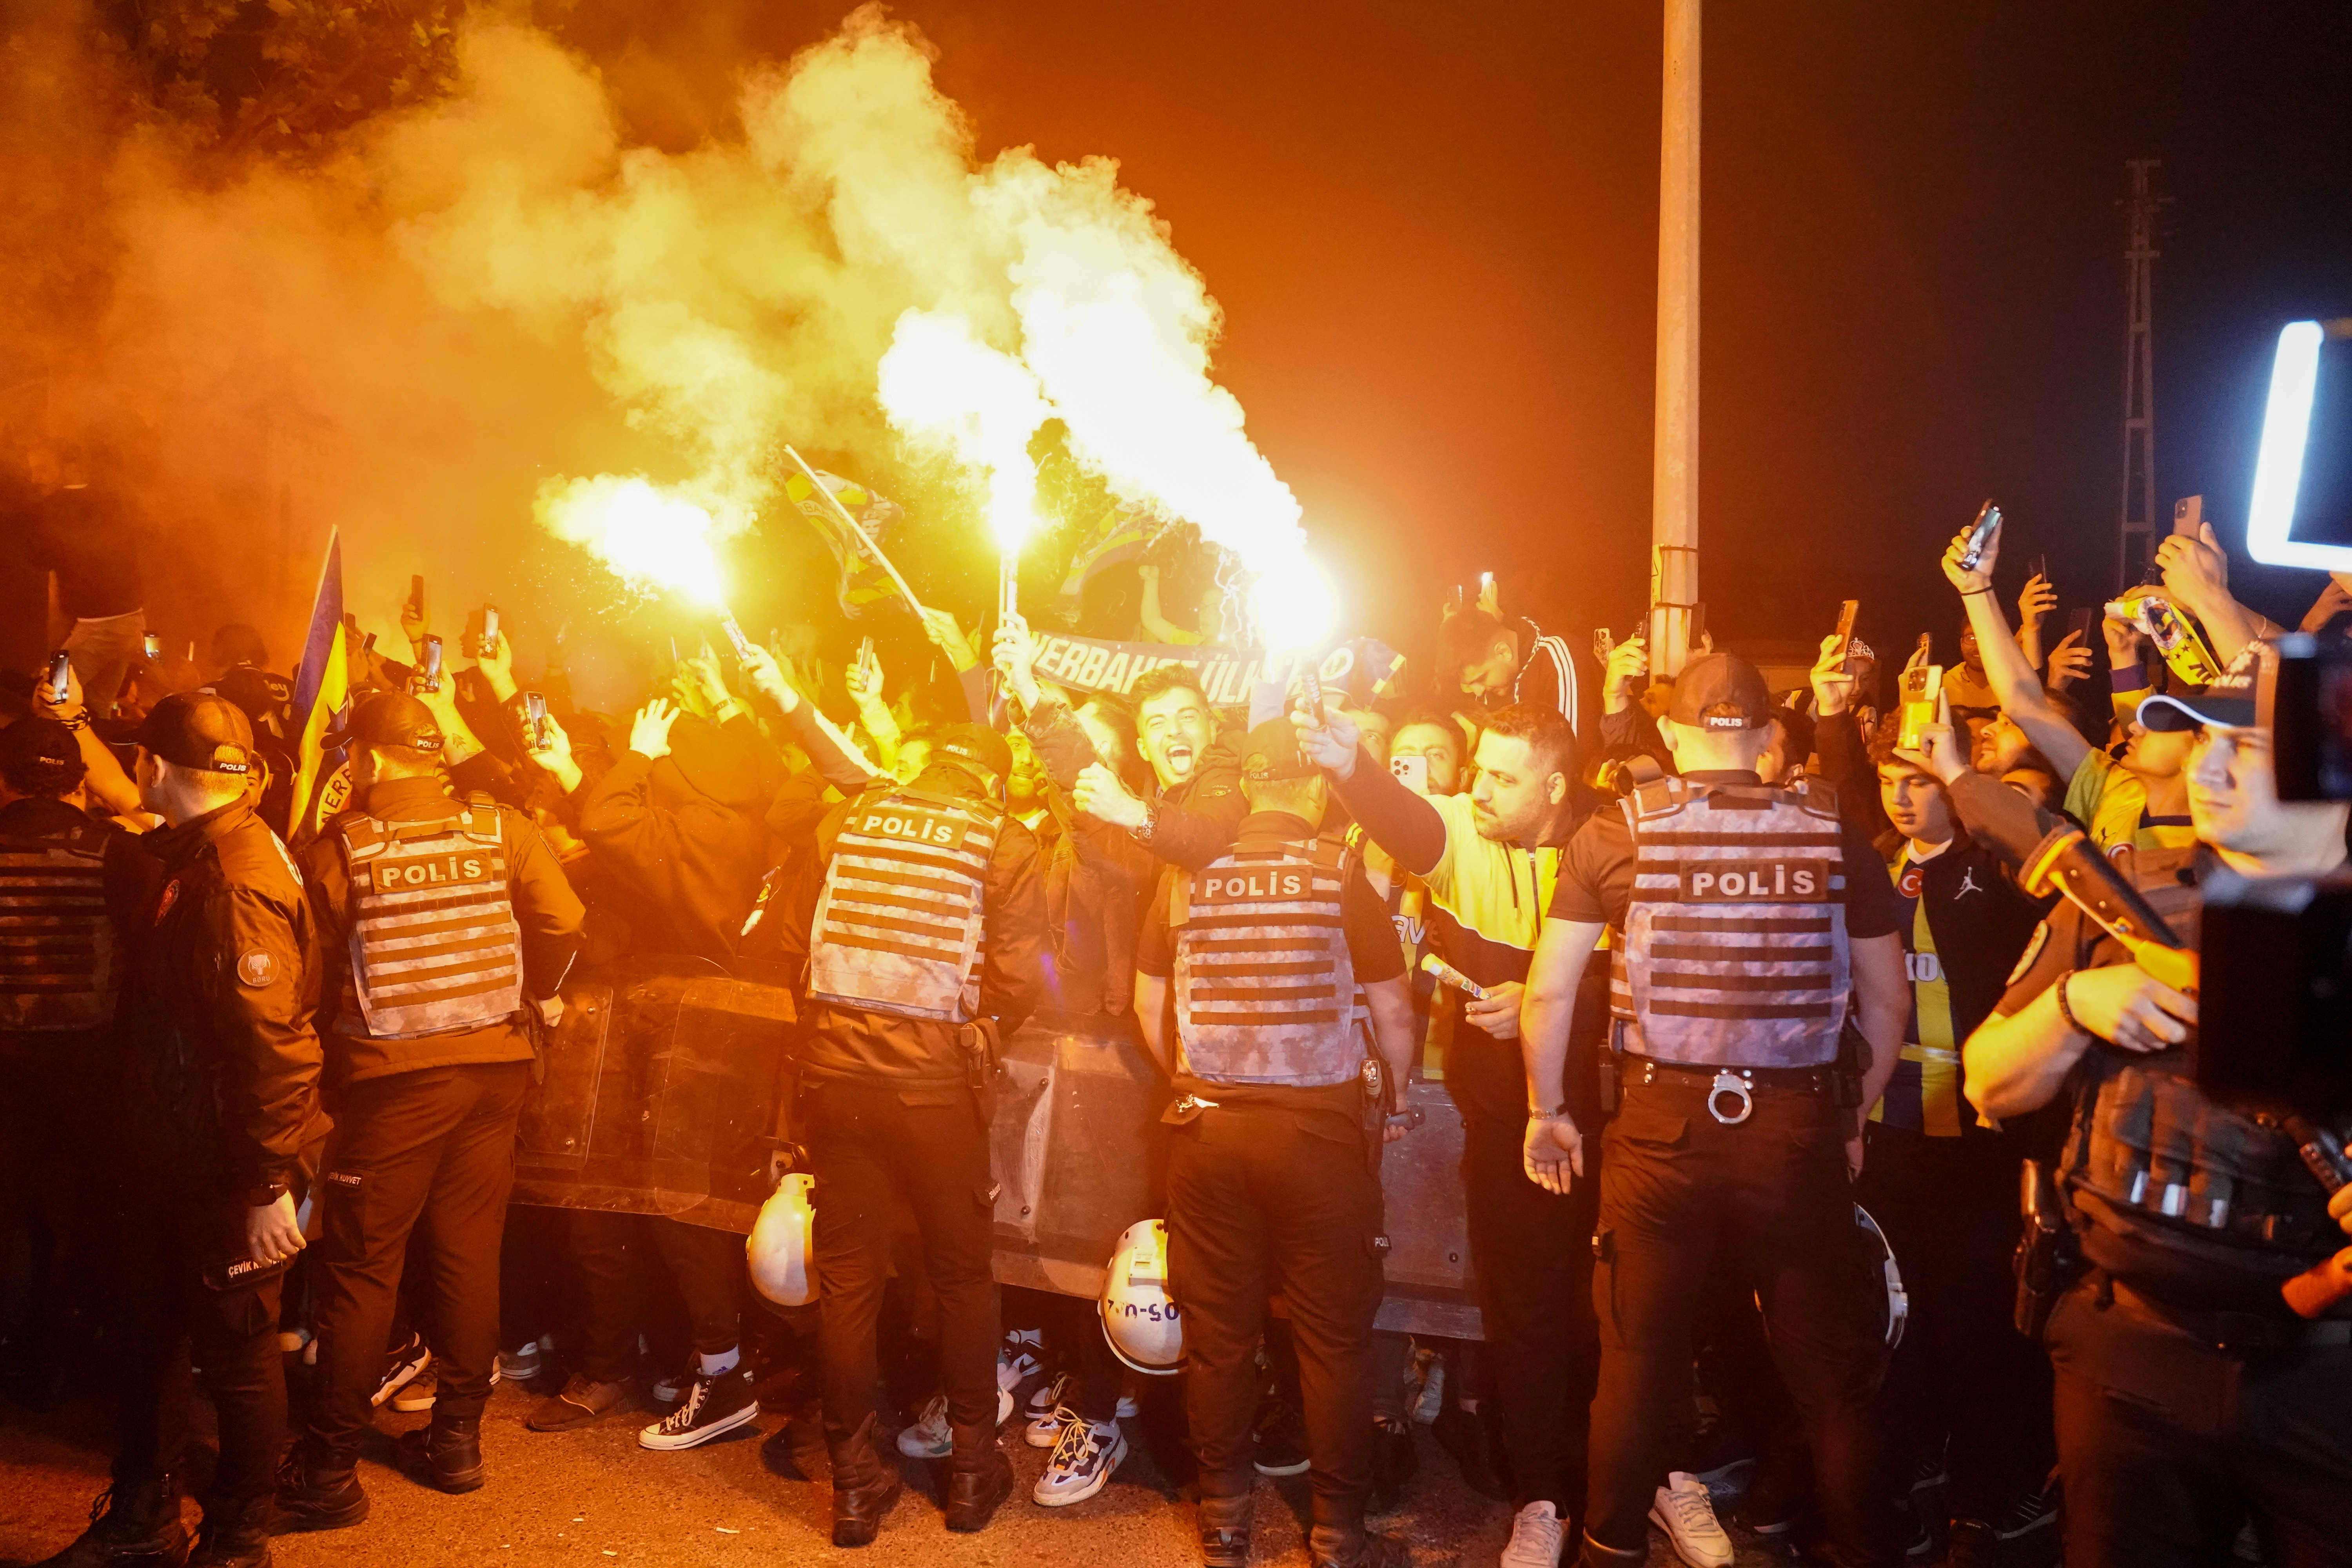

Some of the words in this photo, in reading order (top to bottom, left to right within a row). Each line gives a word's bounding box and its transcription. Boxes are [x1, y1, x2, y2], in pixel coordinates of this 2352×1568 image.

[863, 815, 953, 842] POLİS
[382, 857, 481, 887] POLİS
[1205, 871, 1301, 898] POLİS
[1692, 864, 1815, 896] POLİS
[228, 1260, 252, 1278] ÇEVİK
